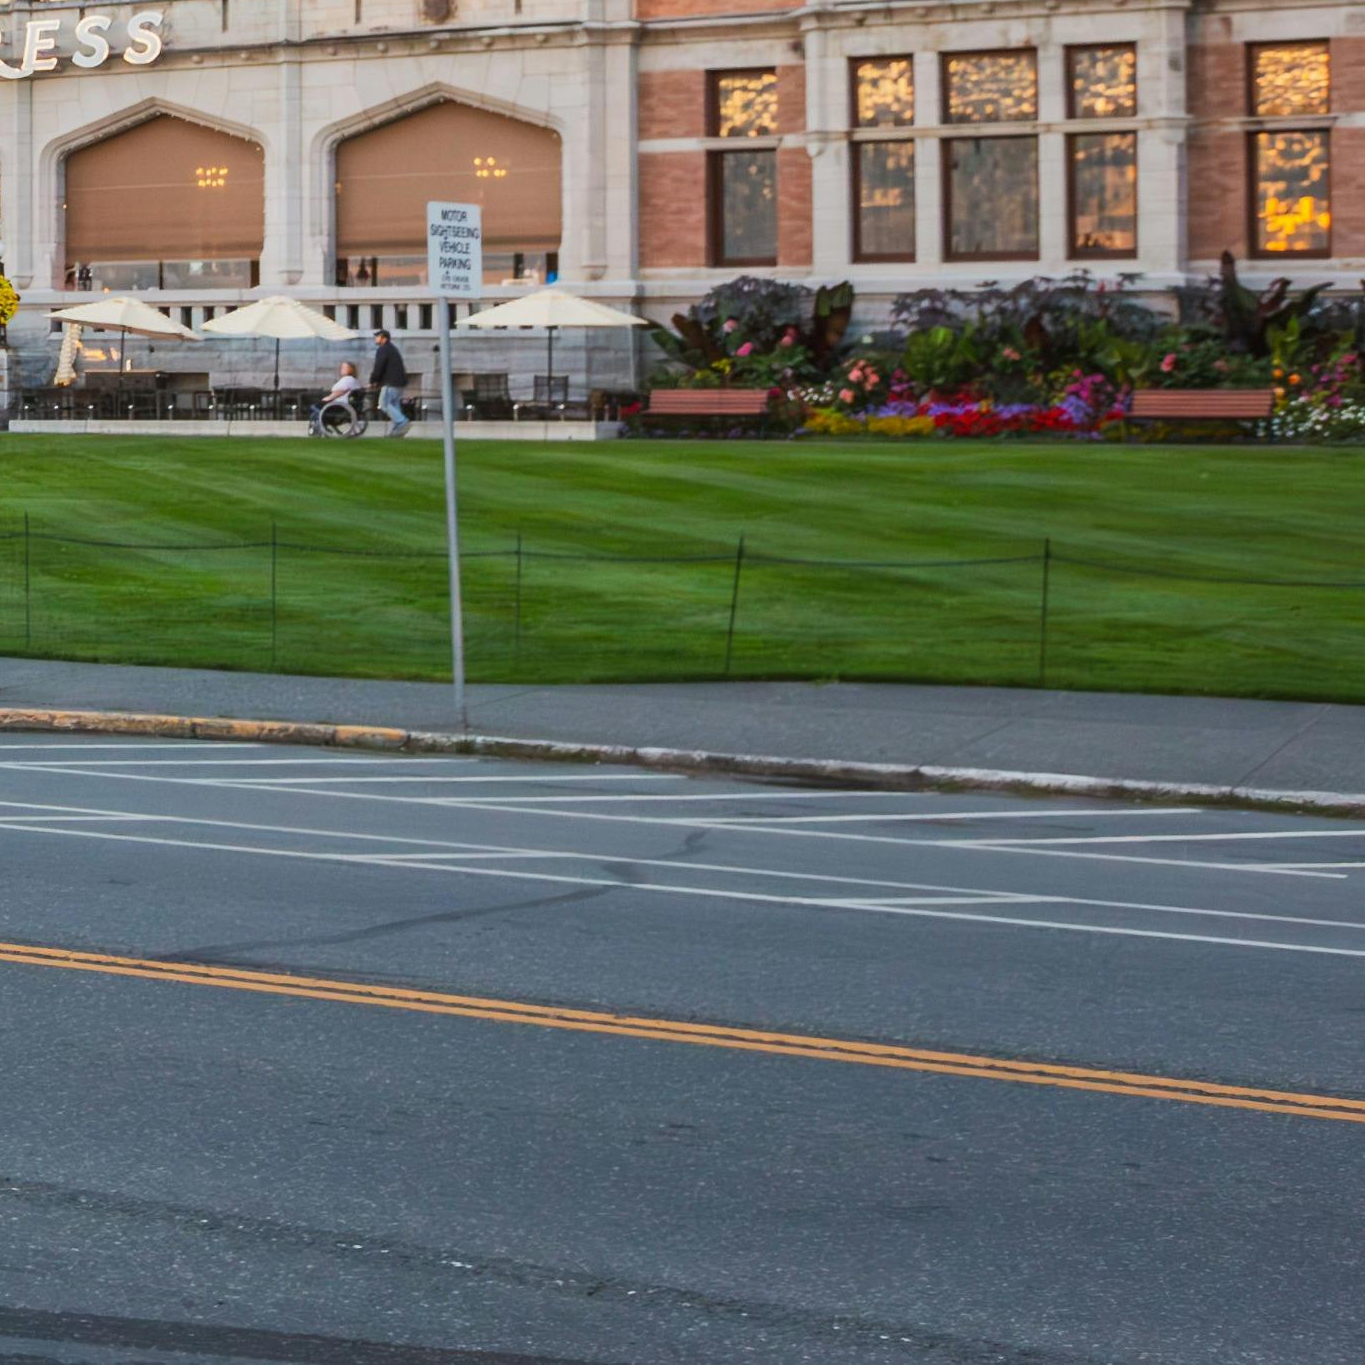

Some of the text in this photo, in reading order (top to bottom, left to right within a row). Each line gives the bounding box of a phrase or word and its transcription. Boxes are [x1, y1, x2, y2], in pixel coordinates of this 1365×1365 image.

[441, 210, 468, 222] MOTOR
[430, 224, 480, 239] SIGHTSEEING
[439, 241, 471, 254] VEHICLE
[439, 257, 471, 270] PARKING
